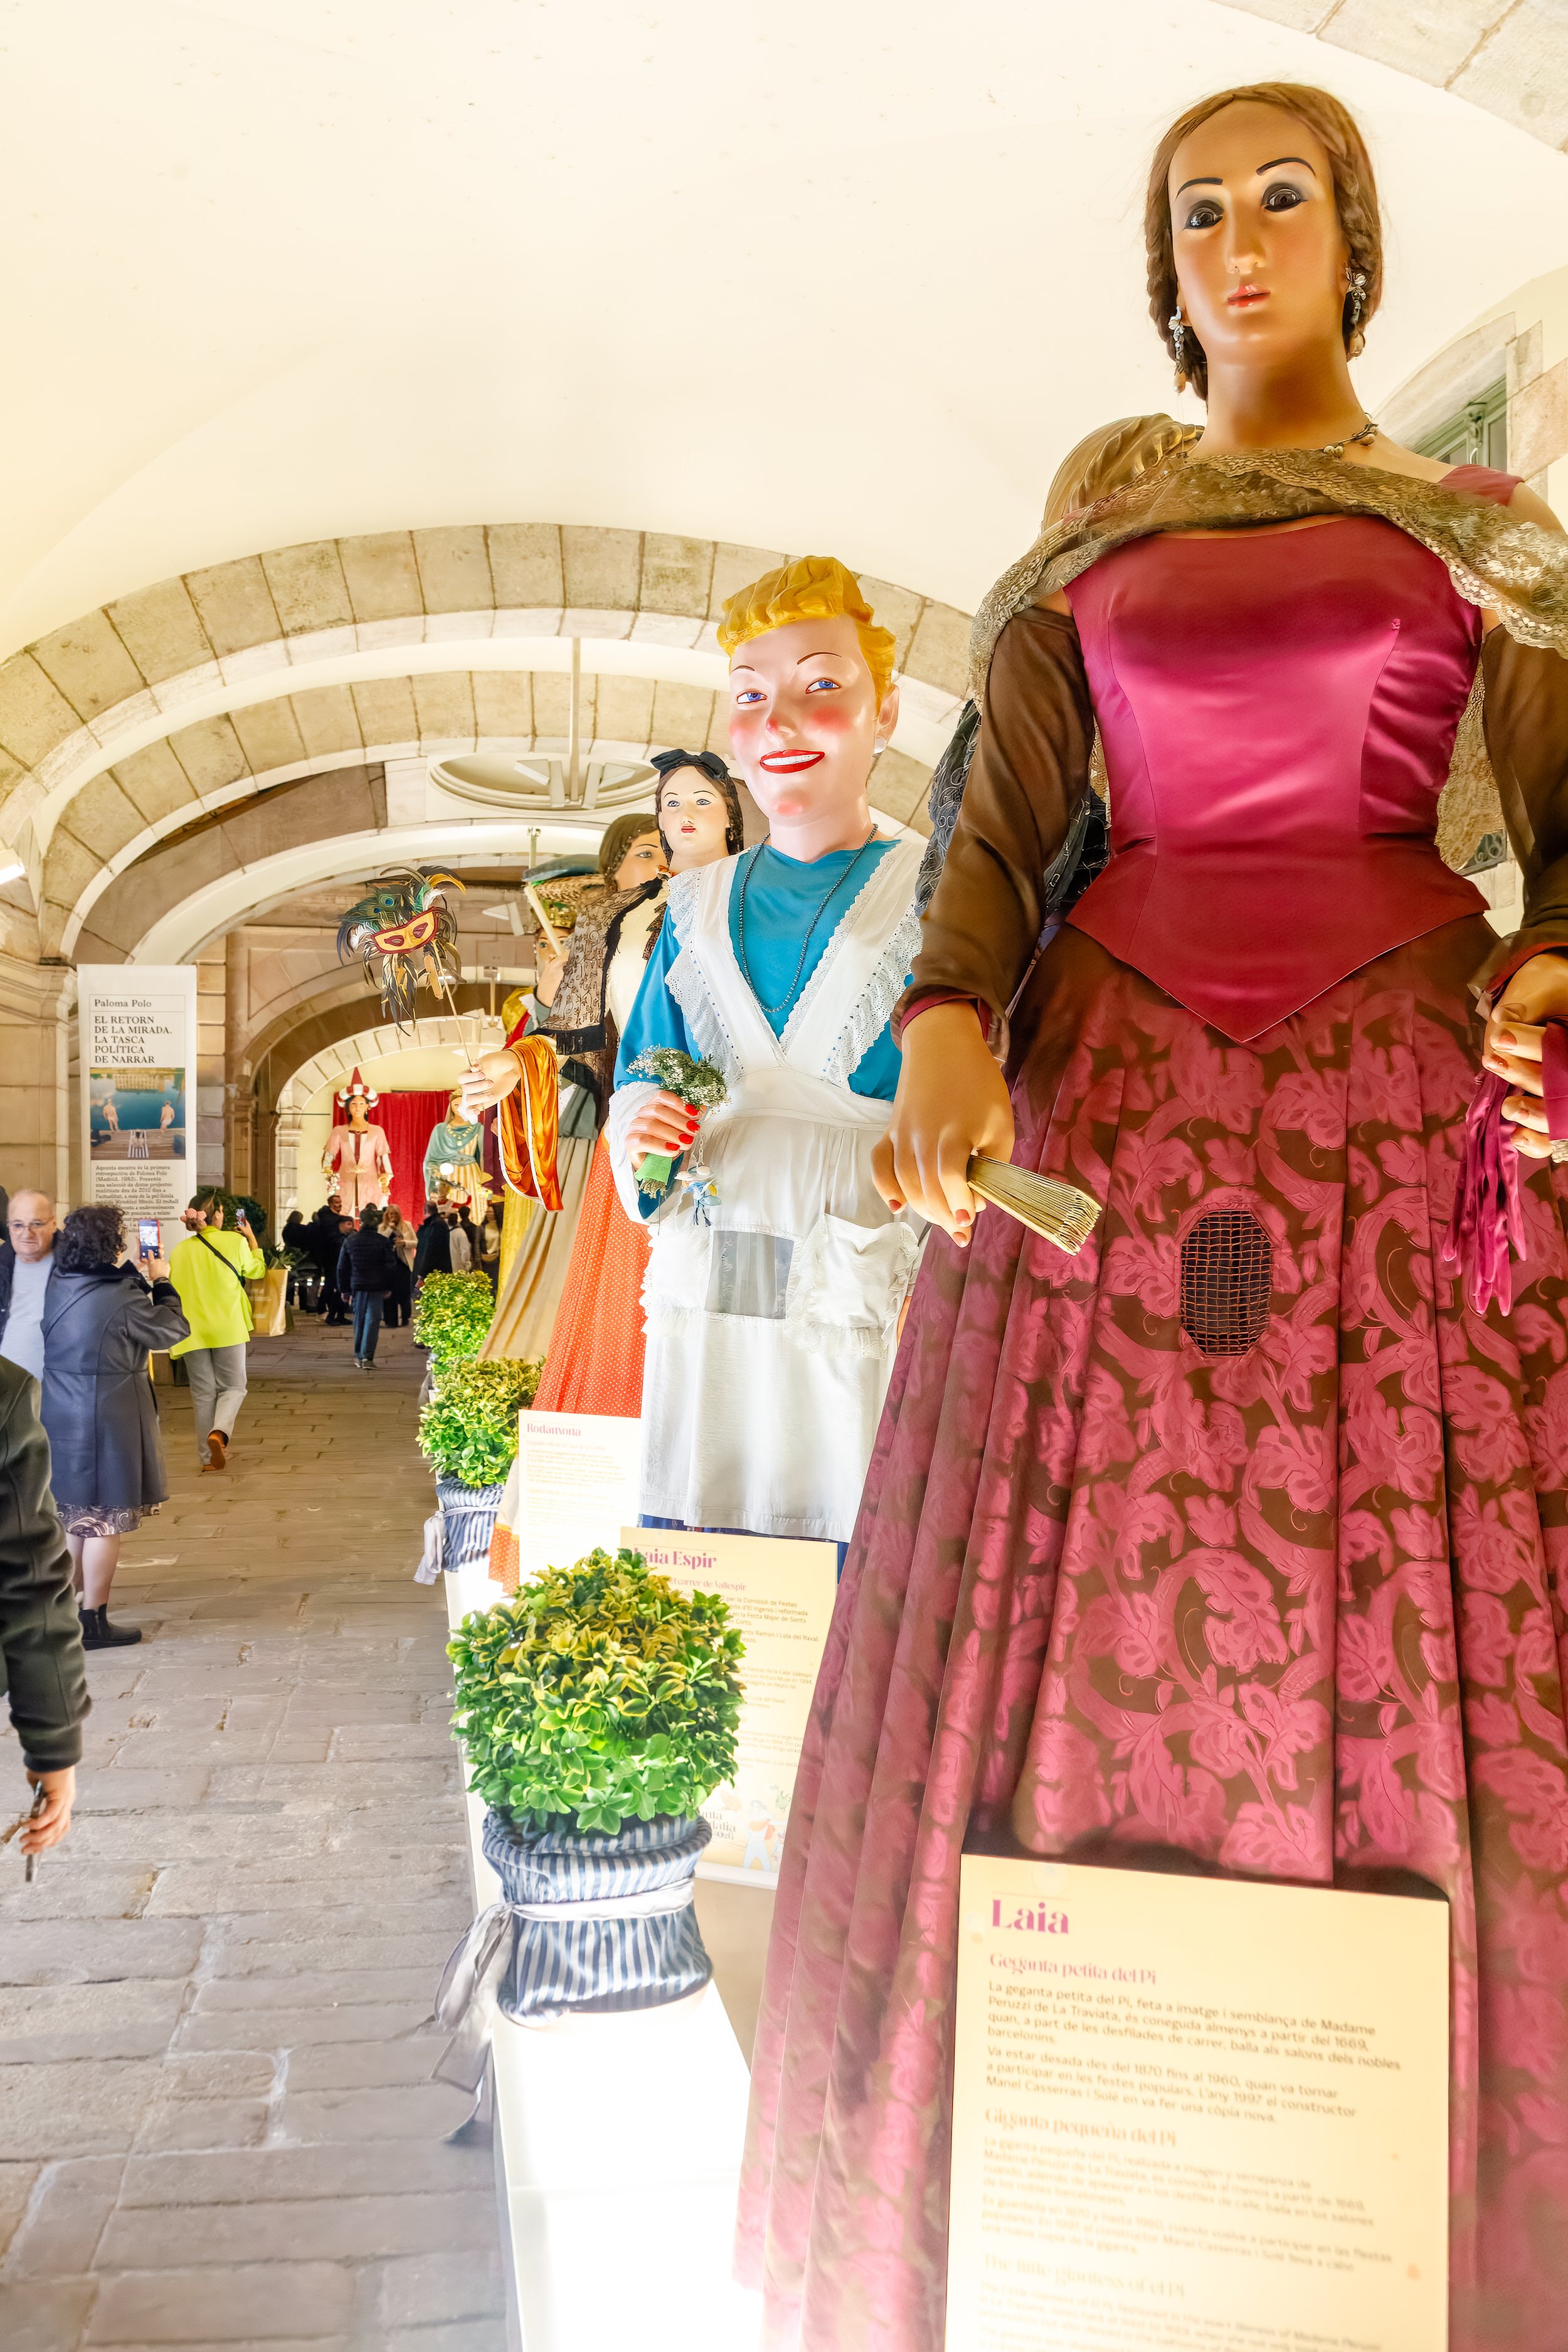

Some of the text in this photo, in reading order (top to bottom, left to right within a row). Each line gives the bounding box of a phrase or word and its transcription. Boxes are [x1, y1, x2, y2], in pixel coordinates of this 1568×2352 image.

[95, 999, 152, 1007] Paloma Polo
[95, 1015, 154, 1024] EL RETORN
[95, 1025, 172, 1034] DE LA MIRADA.
[95, 1036, 145, 1044] LA TASCA
[95, 1044, 145, 1054] POLÍTICA
[95, 1055, 155, 1064] DE NARRAR
[673, 1551, 716, 1569] Espir
[992, 1899, 1069, 1934] Laia
[990, 1952, 1157, 1985] Geganta petita del Pi
[988, 1980, 1002, 1992] La
[1005, 1985, 1052, 1998] geganta
[1056, 1990, 1093, 2003] petita
[1096, 1993, 1115, 2005] del
[1136, 1998, 1162, 2010] feta
[1176, 2002, 1219, 2020] imatge
[1300, 2016, 1316, 2028] de
[1320, 2020, 1375, 2035] Madame
[988, 1994, 1030, 2010] Peruzzi
[1034, 2000, 1048, 2012] de
[1052, 2002, 1066, 2014] La
[1125, 2011, 1138, 2023] és
[1142, 2016, 1201, 2032] coneguda
[1205, 2021, 1256, 2040] almenys
[1271, 2032, 1305, 2043] partir
[1311, 2033, 1330, 2046] del
[1034, 2018, 1059, 2030] part
[1062, 2018, 1078, 2030] de
[1081, 2021, 1098, 2033] les
[1167, 2032, 1183, 2043] de
[1229, 2039, 1259, 2052] balla
[1263, 2043, 1279, 2055] als
[1283, 2047, 1324, 2060] salons
[1327, 2050, 1353, 2063] dels
[1357, 2056, 1401, 2069] nobles
[987, 2044, 1002, 2056] Va
[1005, 2049, 1035, 2060] estar
[1086, 2057, 1107, 2069] des
[1111, 2060, 1130, 2072] del
[1165, 2066, 1189, 2079] fins
[1192, 2070, 1204, 2081] al
[1244, 2079, 1276, 2091] quan
[1280, 2084, 1295, 2092] va
[1298, 2084, 1339, 2098] tornar
[986, 2074, 1021, 2088] Manel
[1024, 2078, 1083, 2096] Casserras
[1122, 2094, 1138, 2103] en
[1142, 2097, 1155, 2106] va
[1158, 2096, 1176, 2108] fer
[1180, 2102, 1204, 2112] una
[996, 2062, 1053, 2079] participar
[1057, 2070, 1073, 2079] en
[1076, 2070, 1093, 2082] les
[1096, 2072, 1135, 2087] festes
[1266, 2095, 1277, 2106] el
[1281, 2099, 1357, 2116] constructor
